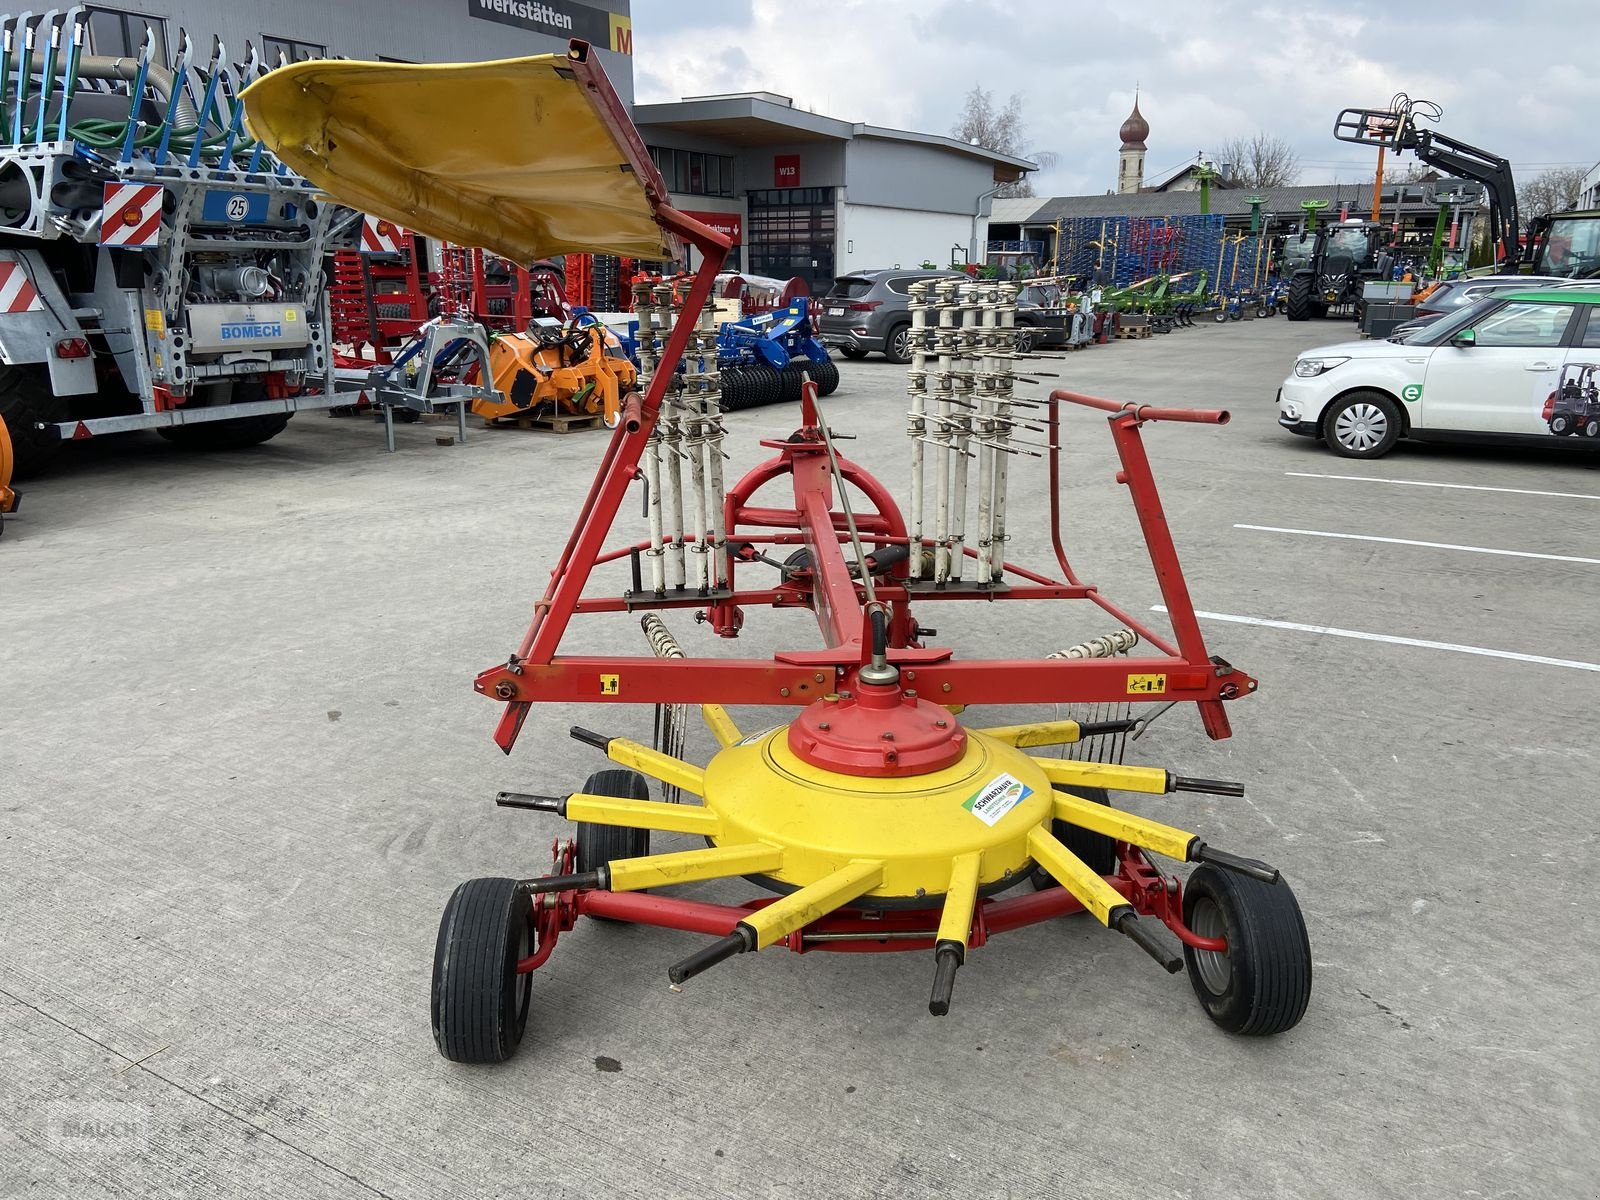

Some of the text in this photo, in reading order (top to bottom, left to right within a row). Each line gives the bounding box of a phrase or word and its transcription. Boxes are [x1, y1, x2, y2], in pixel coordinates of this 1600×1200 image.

[780, 167, 795, 175] W13
[230, 200, 245, 216] 25
[221, 326, 282, 339] BOMECH
